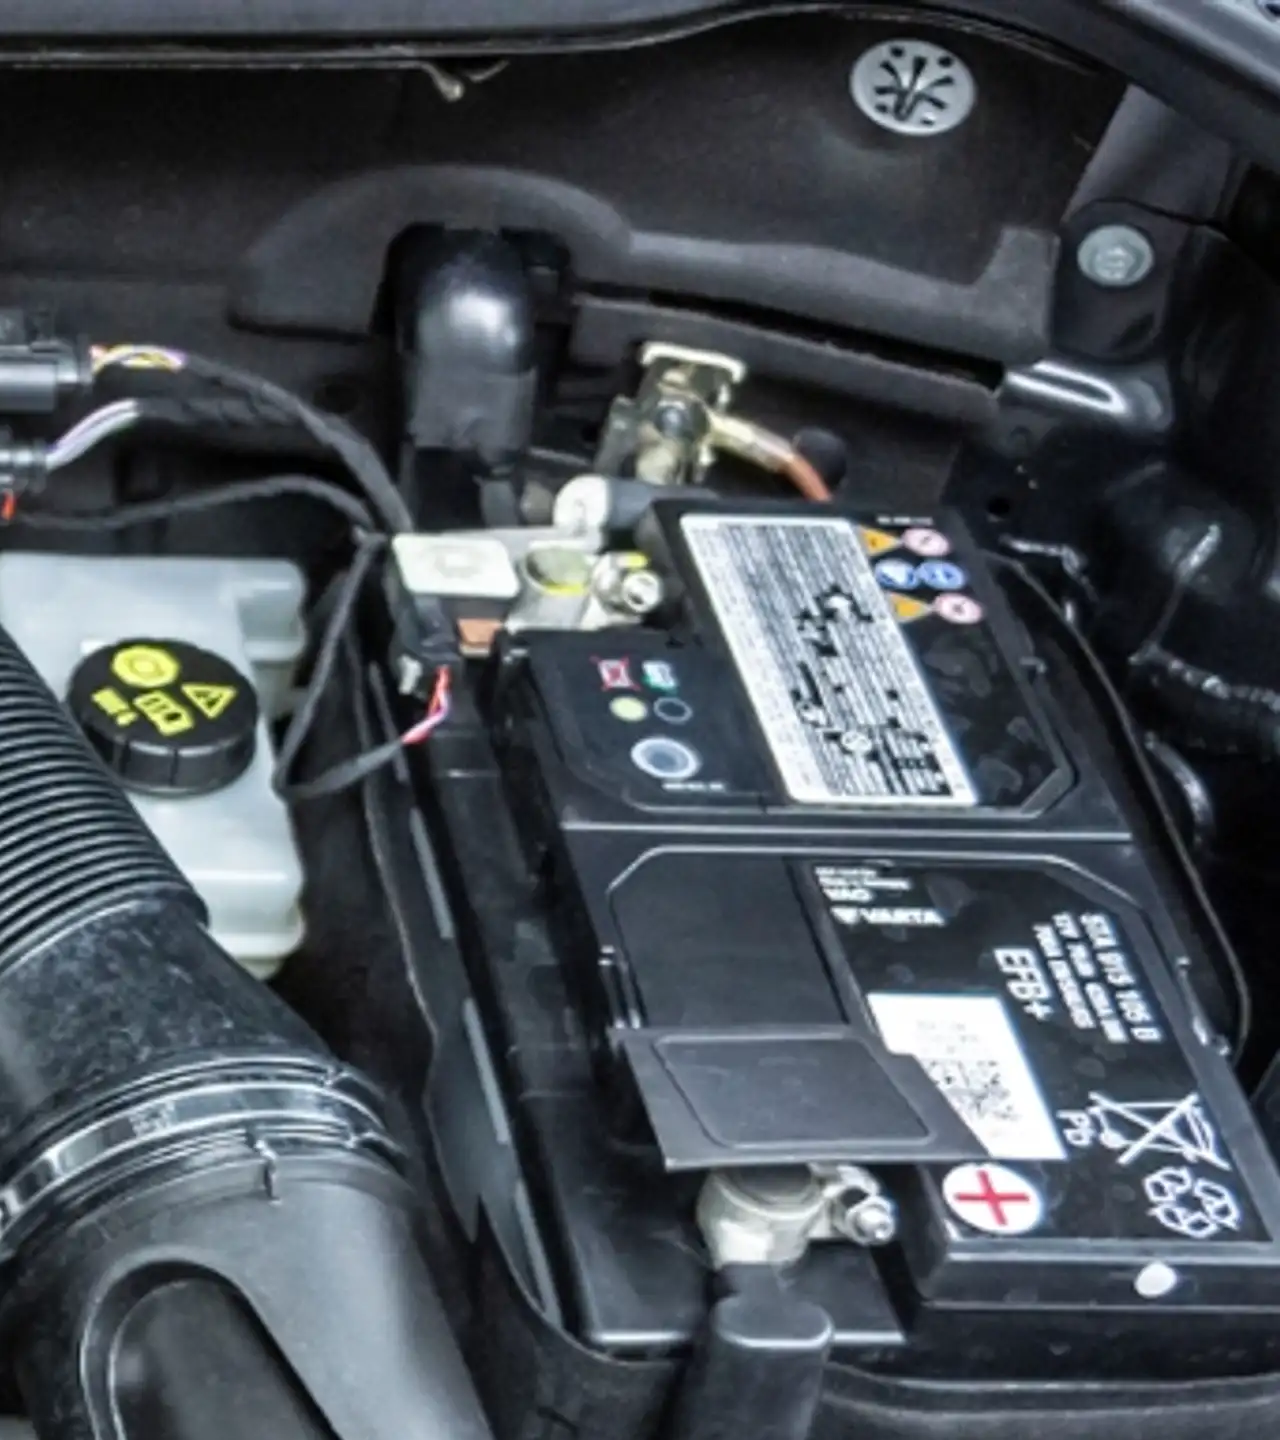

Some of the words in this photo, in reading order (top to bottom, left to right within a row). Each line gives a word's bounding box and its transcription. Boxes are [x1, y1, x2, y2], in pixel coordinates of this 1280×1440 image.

[858, 906, 946, 926] VARTA
[993, 948, 1054, 1020] EFB+
[1056, 1110, 1095, 1146] Pb
